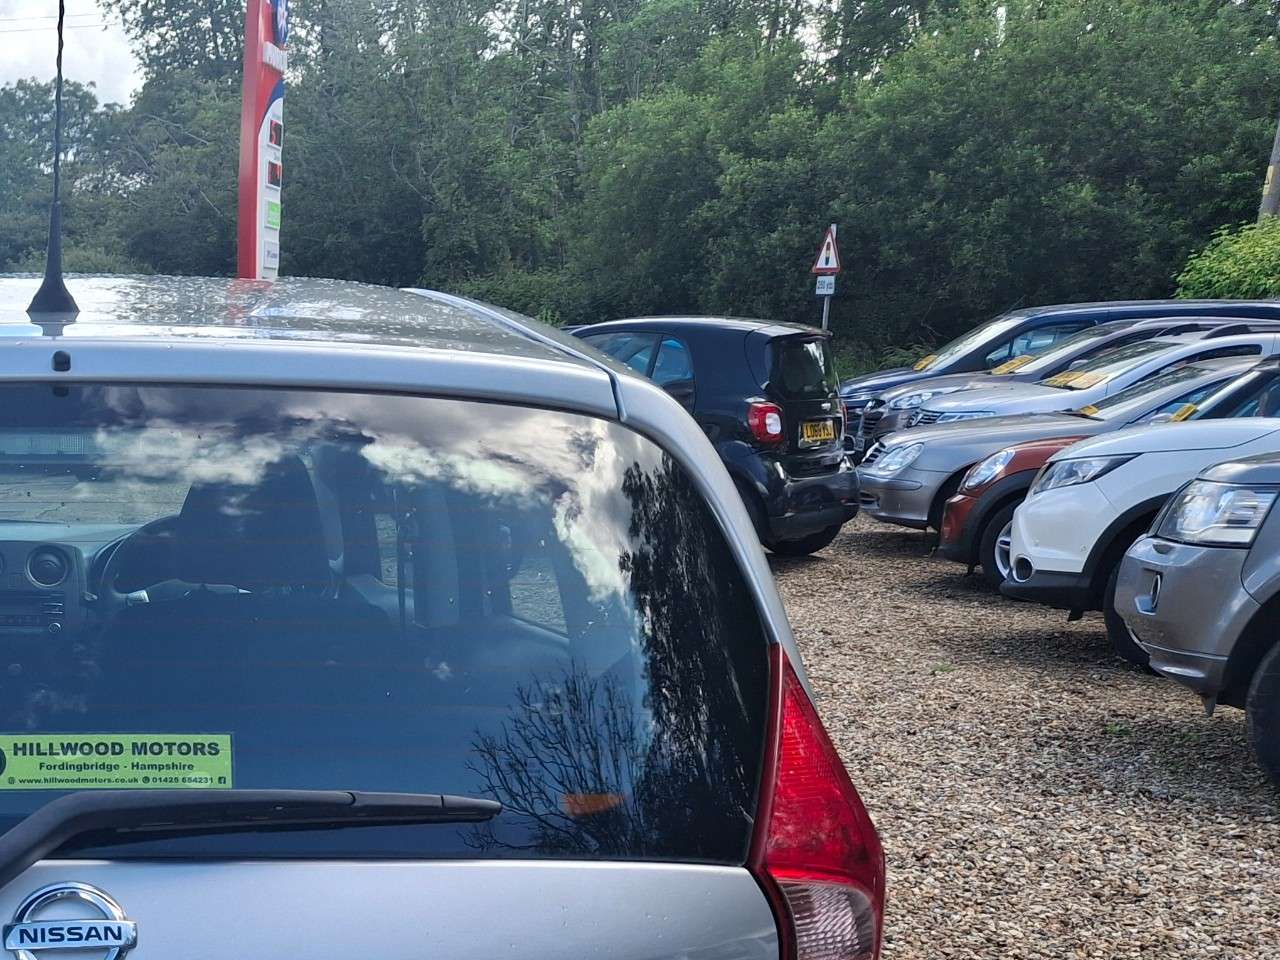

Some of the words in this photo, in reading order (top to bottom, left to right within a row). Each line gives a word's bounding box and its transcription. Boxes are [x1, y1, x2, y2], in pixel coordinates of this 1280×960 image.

[13, 742, 124, 756] HILLWOOD
[131, 742, 220, 756] MOTORS
[39, 762, 120, 773] Fordingbridge
[131, 762, 194, 773] Hampshire
[18, 776, 139, 784] www.hillwoodmotors.co.uk
[20, 926, 122, 943] NISSAN
